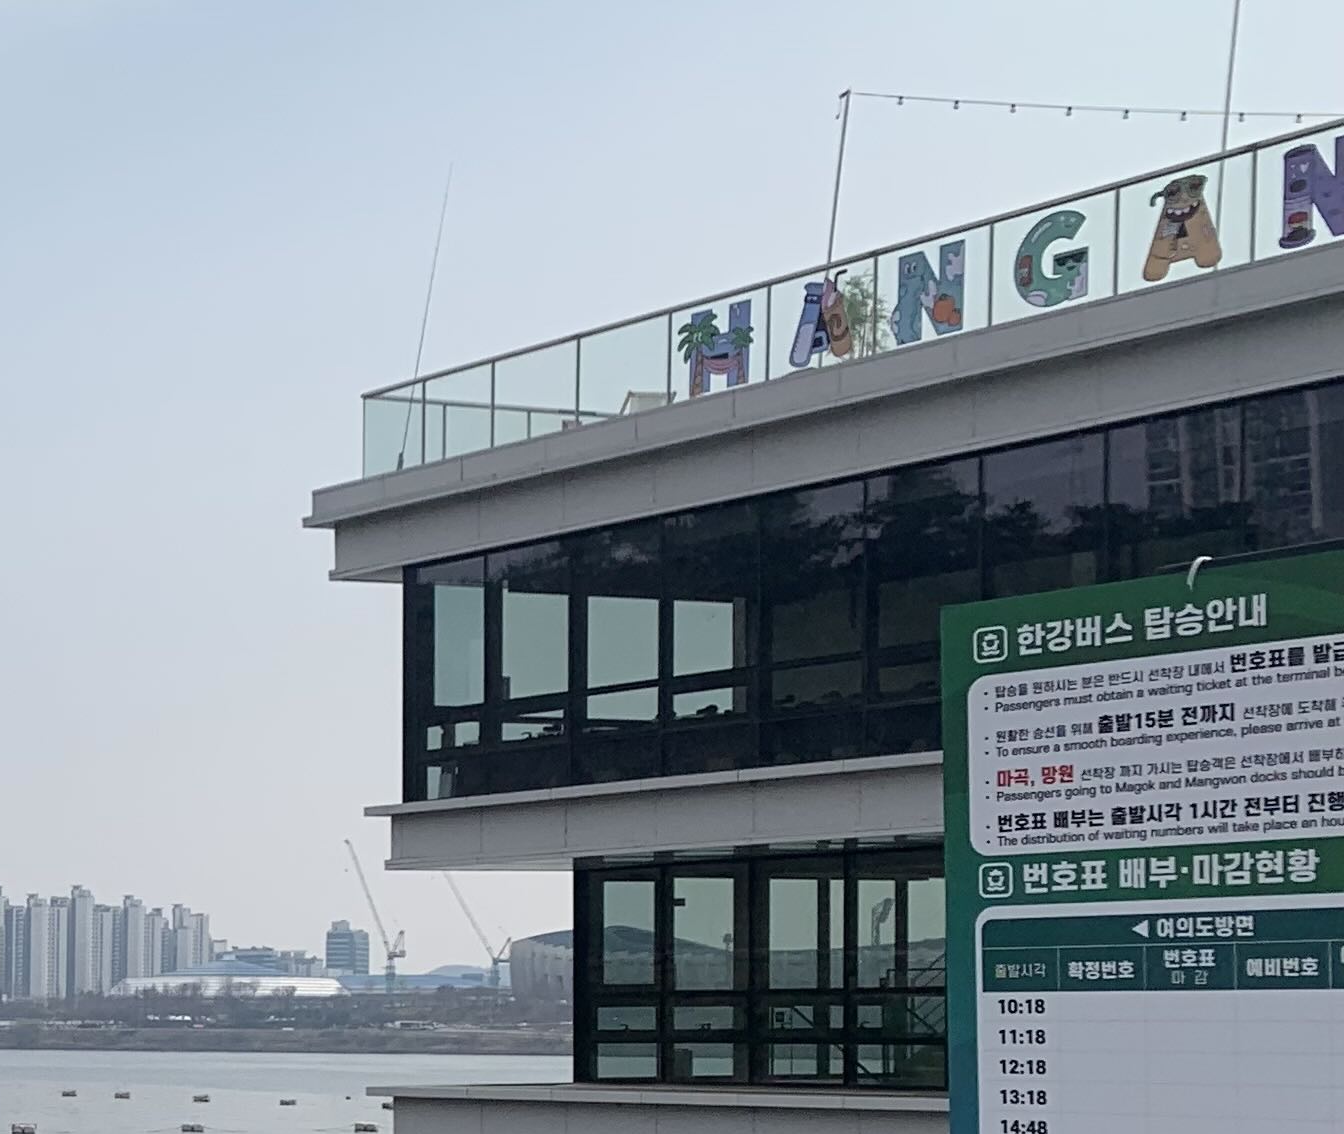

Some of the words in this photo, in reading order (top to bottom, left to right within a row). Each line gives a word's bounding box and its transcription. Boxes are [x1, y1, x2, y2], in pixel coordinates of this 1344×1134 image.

[1017, 612, 1133, 655] 한강버스
[1144, 593, 1267, 640] 탑승안내
[995, 683, 1028, 698] 탑승을
[1033, 679, 1077, 694] 원하시는
[1082, 675, 1104, 689] 분은
[1108, 670, 1143, 686] 반드시
[1148, 666, 1184, 681] 선착장
[1188, 661, 1225, 676] 내에서
[1230, 646, 1305, 673] 번호표를
[995, 698, 1060, 712] Passengers
[1063, 694, 1092, 706] must
[1096, 690, 1133, 701] obtain
[1136, 689, 1144, 698] a
[1148, 684, 1192, 696] waiting
[1196, 679, 1231, 692] ticket
[1235, 677, 1247, 688] at
[1252, 673, 1272, 685] the
[1277, 666, 1330, 683] terminal
[996, 729, 1029, 744] 원활한
[1033, 725, 1066, 740] 승선을
[1071, 722, 1093, 736] 위해
[1098, 709, 1174, 735] 출발15분
[1181, 703, 1235, 726] 전까지
[1243, 703, 1293, 720] 선착장에
[1298, 698, 1336, 714] 도착해
[996, 747, 1009, 757] To
[1012, 744, 1050, 756] ensure
[1053, 743, 1061, 752] a
[1064, 738, 1107, 751] smooth
[1111, 731, 1162, 747] boarding
[1241, 723, 1282, 738] please
[1286, 719, 1323, 731] arrive
[1327, 716, 1340, 727] at
[997, 768, 1035, 787] 마곡,
[1041, 765, 1074, 784] 망원
[1081, 767, 1115, 781] 선착장
[1119, 764, 1142, 778] 까지
[1147, 761, 1182, 775] 가시는
[1187, 756, 1236, 773] 탑승객은
[1240, 750, 1304, 769] 선착장에서
[997, 788, 1062, 802] Passengers
[1065, 785, 1097, 799] going
[1100, 784, 1112, 794] to
[1115, 779, 1155, 794] Magok
[1159, 778, 1181, 789] and
[1184, 775, 1247, 789] Mangwon
[1250, 770, 1287, 783] docks
[1291, 766, 1334, 779] should
[998, 812, 1047, 833] 번호표
[1053, 809, 1104, 828] 배부는
[1111, 802, 1182, 825] 출발시각
[1189, 799, 1237, 819] 1시간
[1244, 794, 1299, 816] 전부터
[998, 836, 1018, 846] The
[1021, 832, 1090, 846] distribution
[1092, 831, 1100, 841] of
[1103, 829, 1147, 841] waiting
[1151, 825, 1204, 837] numbers
[1207, 822, 1229, 834] will
[1232, 821, 1259, 833] take
[1263, 819, 1297, 833] place
[1301, 819, 1317, 828] an
[1022, 859, 1108, 894] 번호표
[1156, 915, 1254, 938] 여의도방면
[995, 963, 1046, 978] 출발시각
[1068, 961, 1135, 980] 확정번호
[1164, 949, 1216, 968] 번호표
[1246, 957, 1319, 977] 예비번호
[998, 999, 1046, 1014] 10:18
[998, 1029, 1046, 1045] 11:18
[999, 1059, 1047, 1075] 12:18
[1000, 1089, 1047, 1105] 13:18
